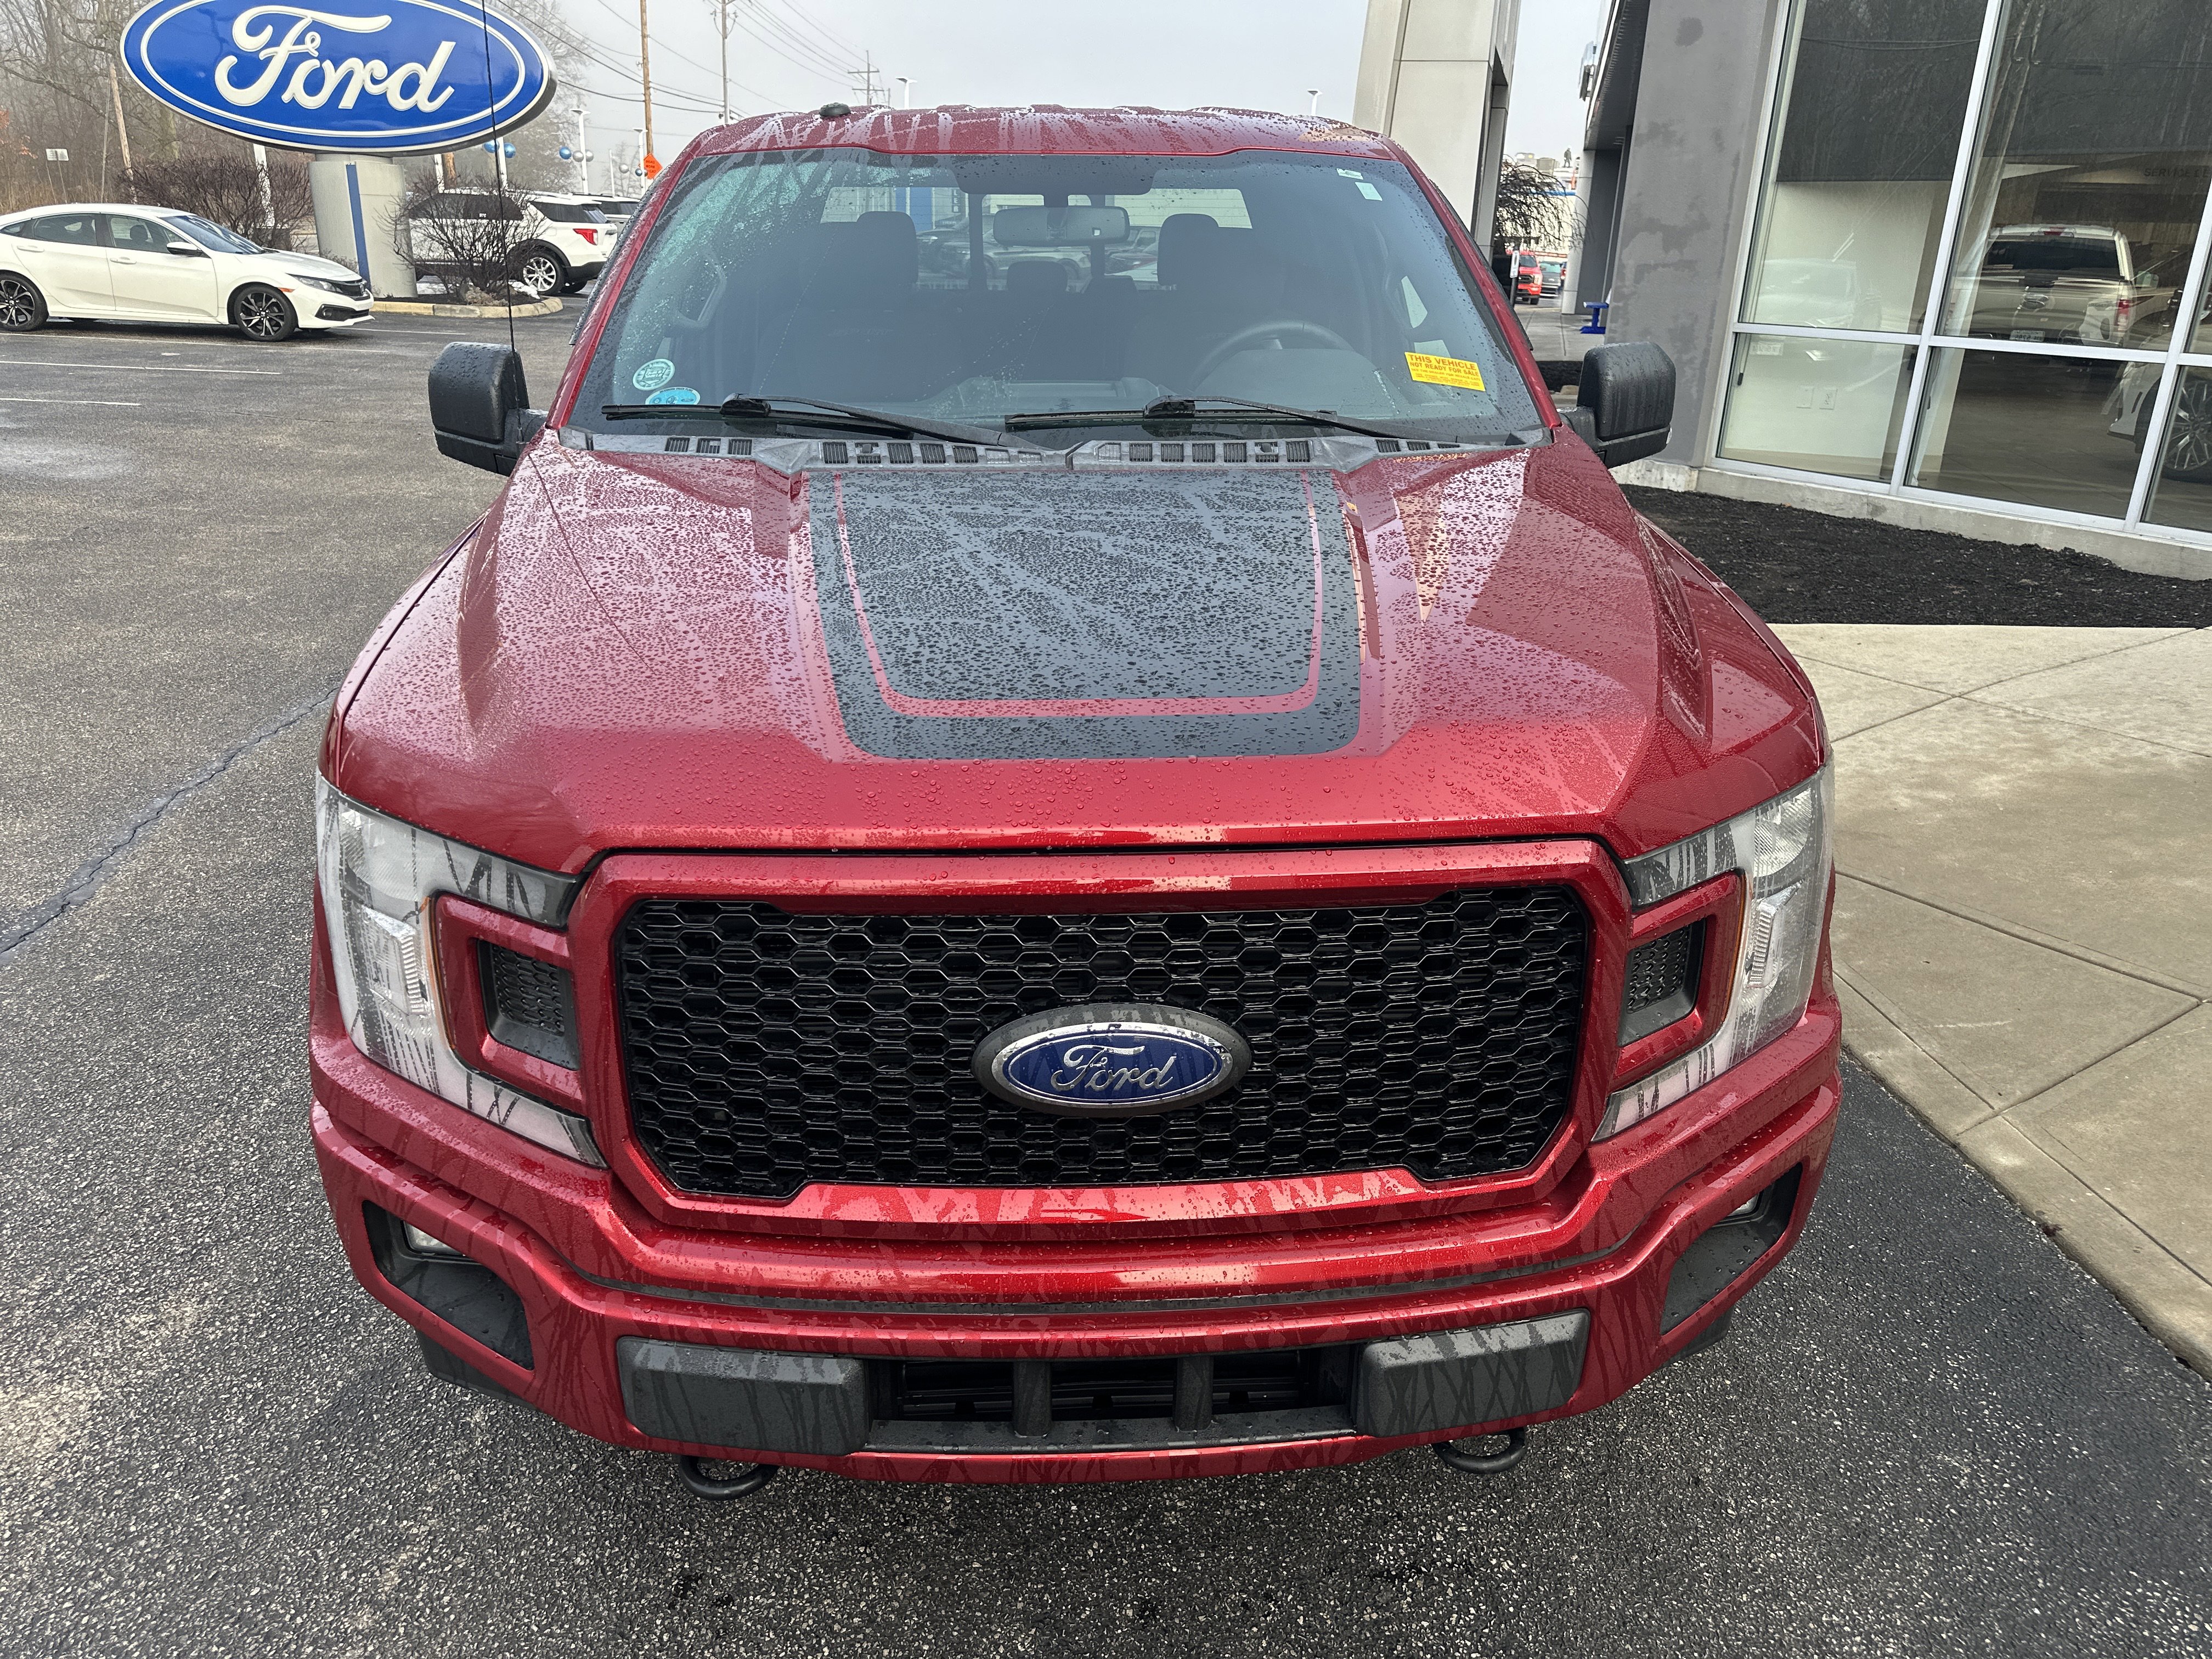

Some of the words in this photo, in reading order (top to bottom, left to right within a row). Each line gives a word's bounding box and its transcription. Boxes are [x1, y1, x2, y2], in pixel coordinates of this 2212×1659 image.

[215, 5, 456, 113] Ford
[1408, 354, 1432, 363] THIS
[1434, 358, 1477, 370] VEHICLE
[1425, 363, 1447, 371] READY
[1050, 1044, 1177, 1092] Ford
